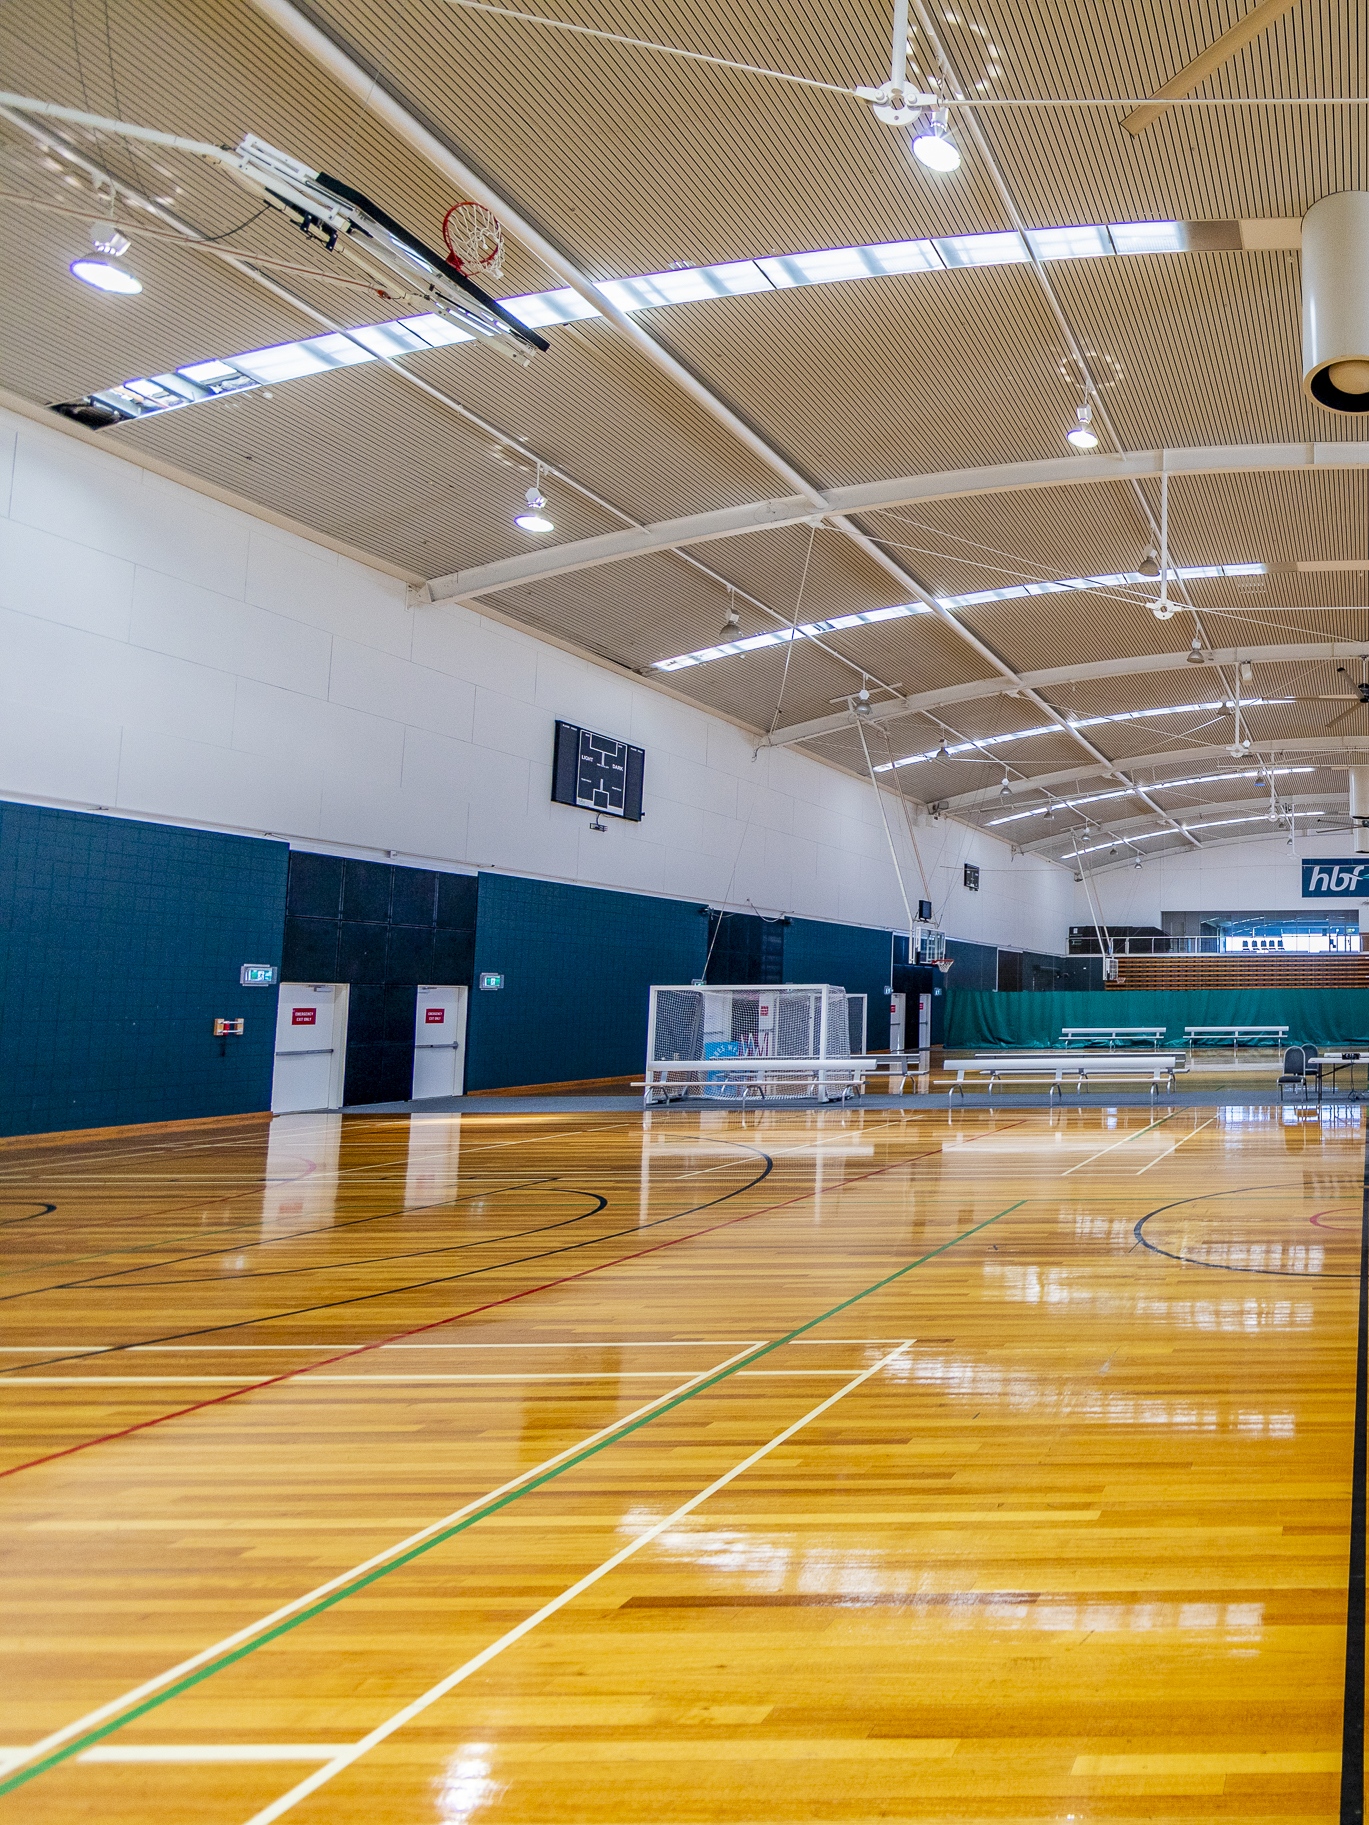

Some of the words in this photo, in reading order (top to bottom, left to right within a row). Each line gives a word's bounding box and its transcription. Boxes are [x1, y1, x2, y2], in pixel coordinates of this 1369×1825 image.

[581, 754, 593, 762] LIGHT
[612, 763, 624, 771] DARK
[1308, 865, 1365, 891] hbf
